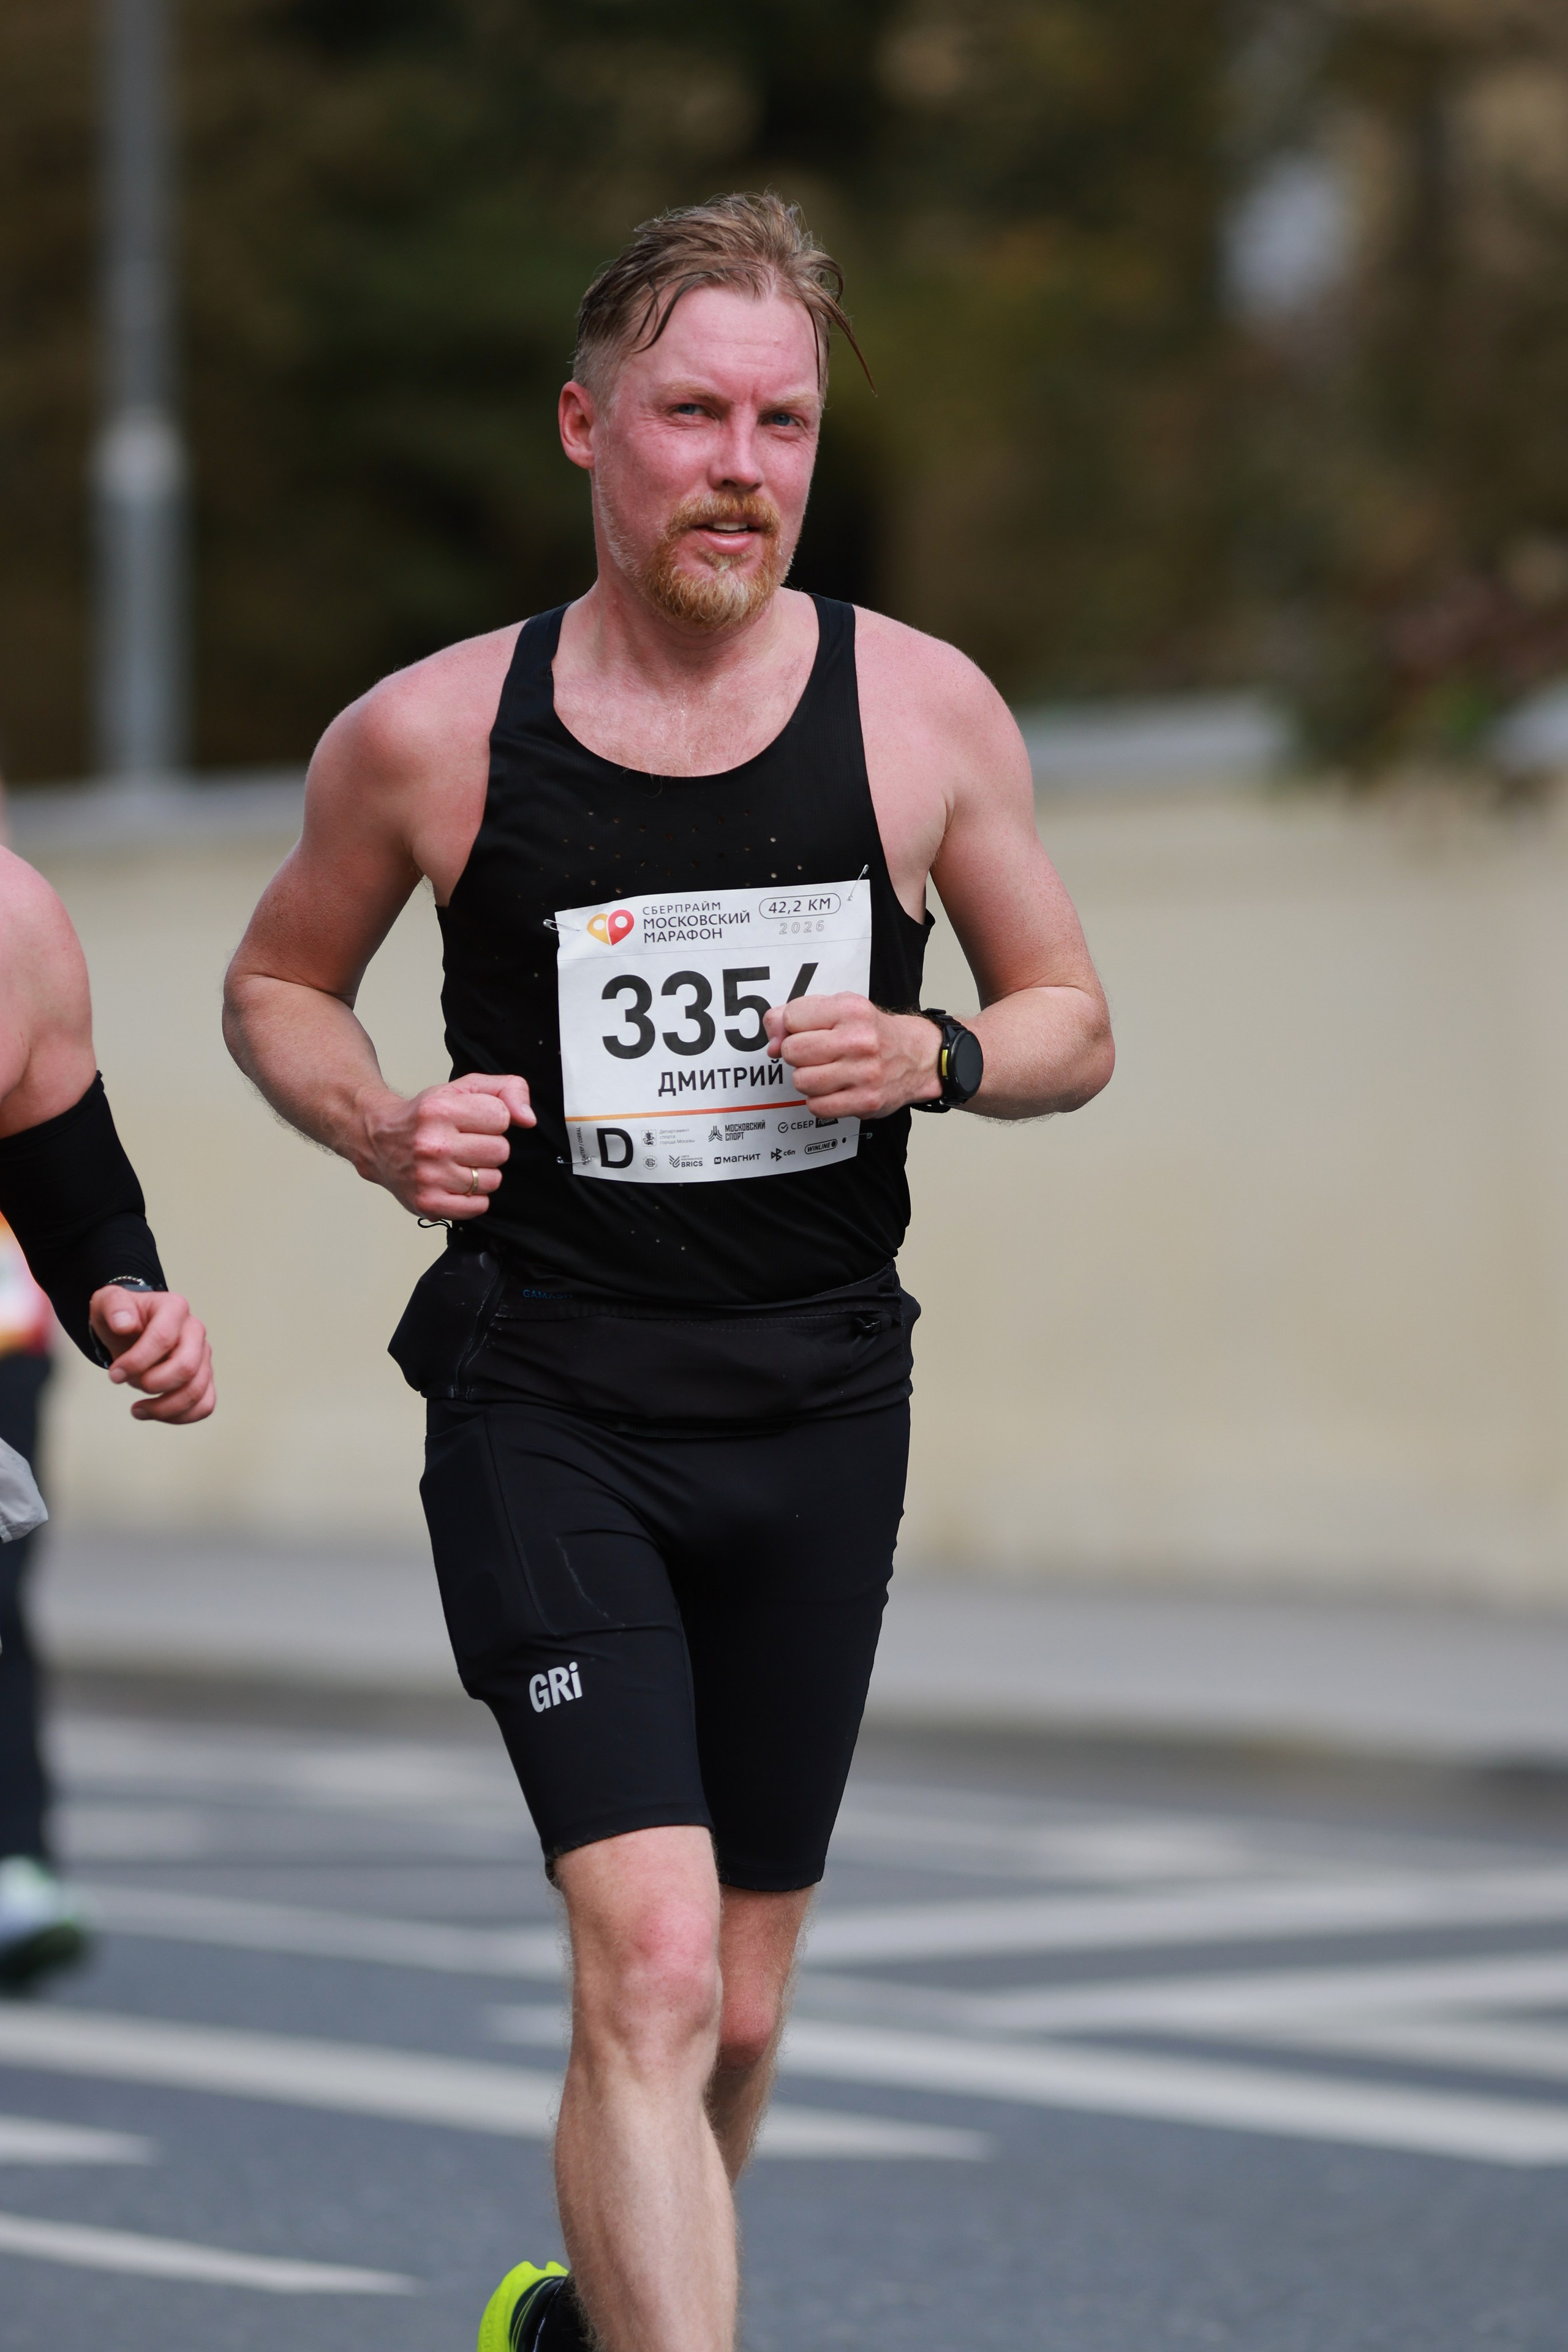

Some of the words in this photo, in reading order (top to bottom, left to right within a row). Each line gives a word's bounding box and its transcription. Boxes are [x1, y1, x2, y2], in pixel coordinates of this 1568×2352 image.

[642, 902, 722, 916] СБЕРПРАЙМ
[768, 900, 801, 914] 42,2
[808, 897, 831, 911] КМ
[643, 909, 750, 930] МОСКОВСКИЙ
[644, 927, 723, 943] МАРАФОН
[778, 920, 824, 935] 2026
[658, 1058, 784, 1097] ДМИТРИЙ
[725, 1120, 766, 1133] МОСКОВСКИЙ
[791, 1120, 814, 1130] СБЕР
[725, 1131, 745, 1141] СПОРТ
[596, 1128, 634, 1169] D
[807, 1142, 831, 1153] WINLINE
[529, 1661, 583, 1713] GRi
